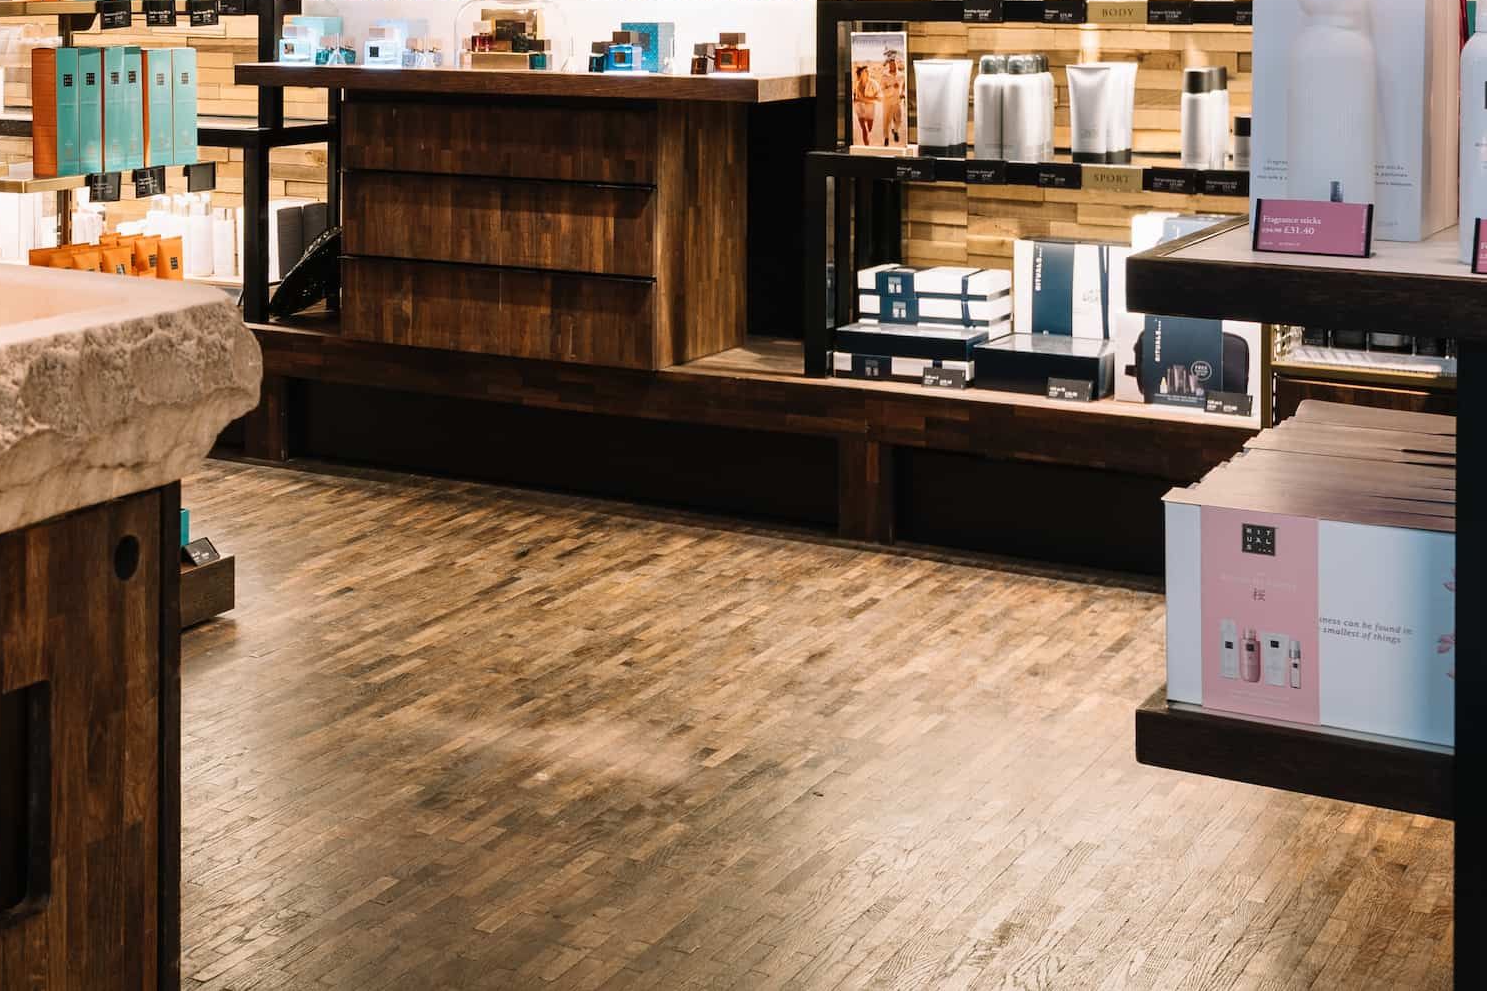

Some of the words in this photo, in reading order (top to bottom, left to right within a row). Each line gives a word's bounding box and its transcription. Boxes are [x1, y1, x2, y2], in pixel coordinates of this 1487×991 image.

[1102, 8, 1134, 18] BODY
[1093, 173, 1130, 184] SPORT
[1262, 215, 1299, 226] Fragrance
[1300, 216, 1322, 225] sticks
[1373, 631, 1401, 645] things
